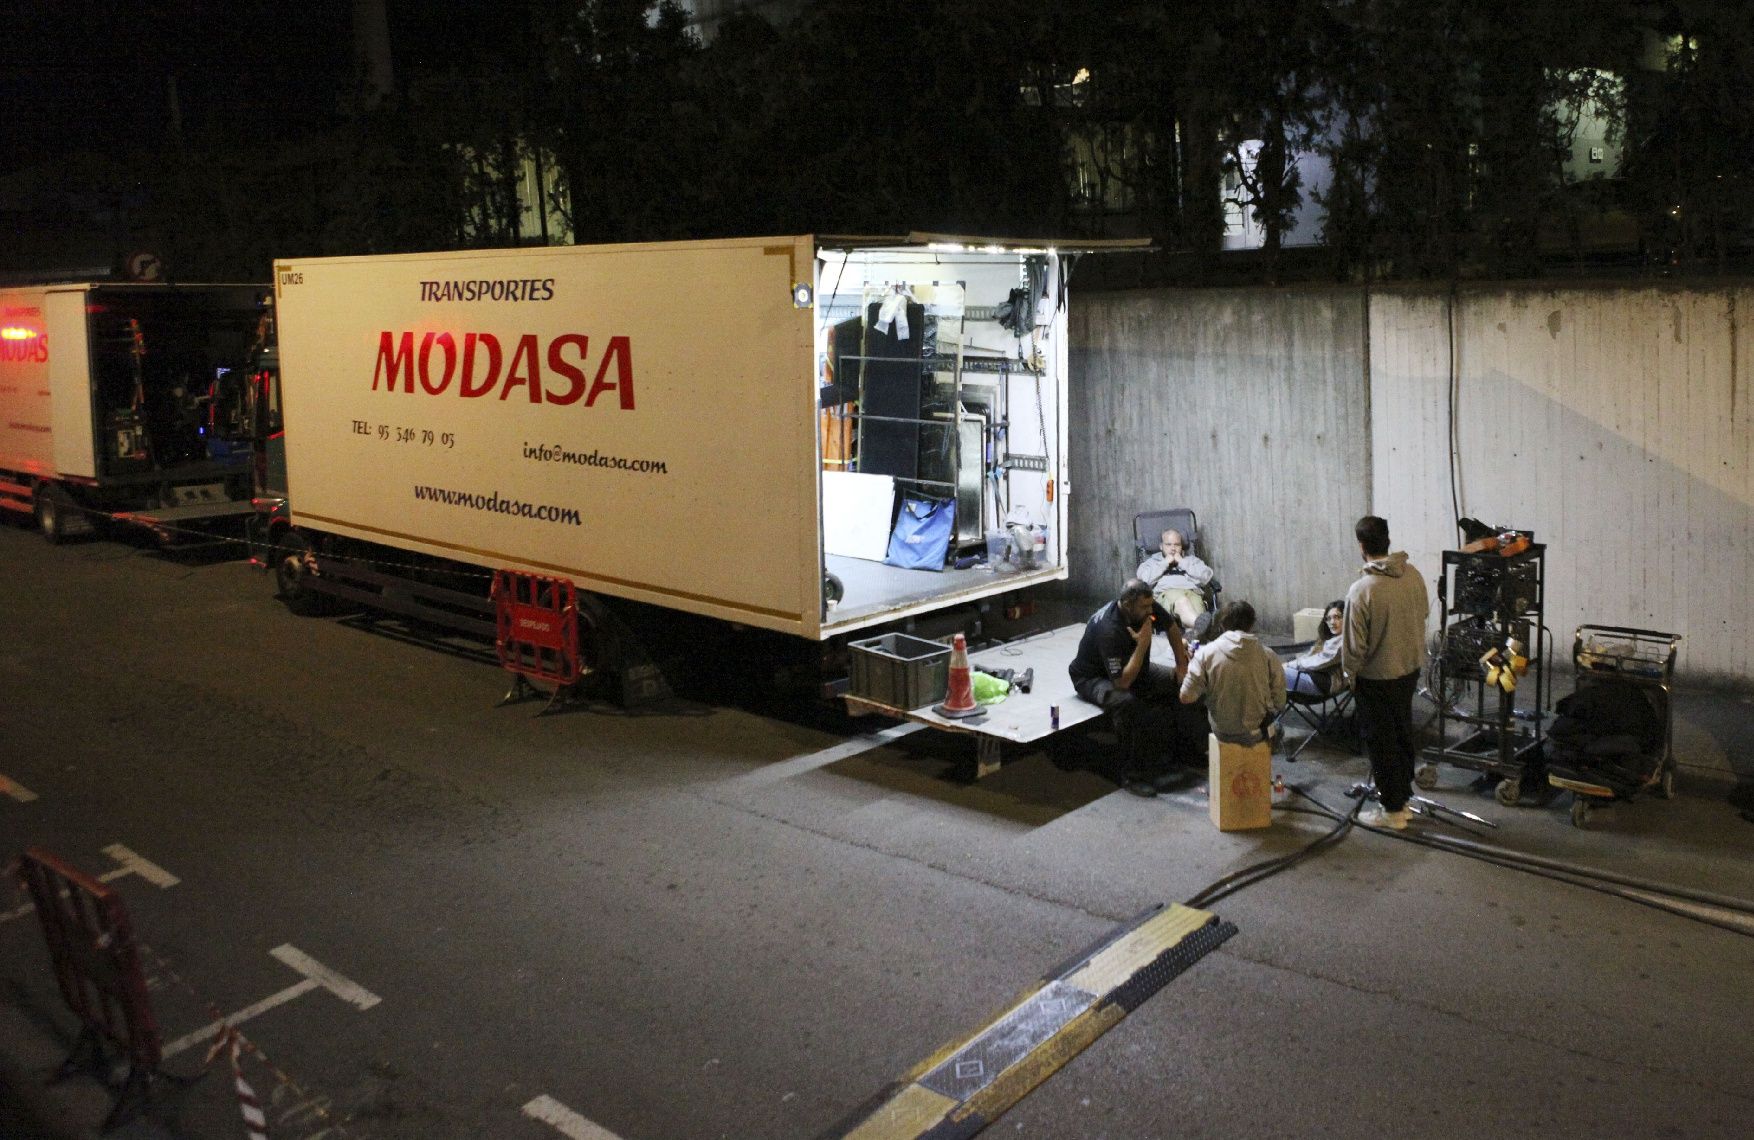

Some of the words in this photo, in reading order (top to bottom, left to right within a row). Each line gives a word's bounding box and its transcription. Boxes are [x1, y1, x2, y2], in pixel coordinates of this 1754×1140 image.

[420, 278, 555, 302] TRANSPORTES
[372, 331, 635, 410] MODASA
[352, 420, 372, 435] TEL:
[422, 429, 434, 446] 79
[523, 441, 668, 474] info@modasa.com
[414, 485, 582, 526] www.modasa.com
